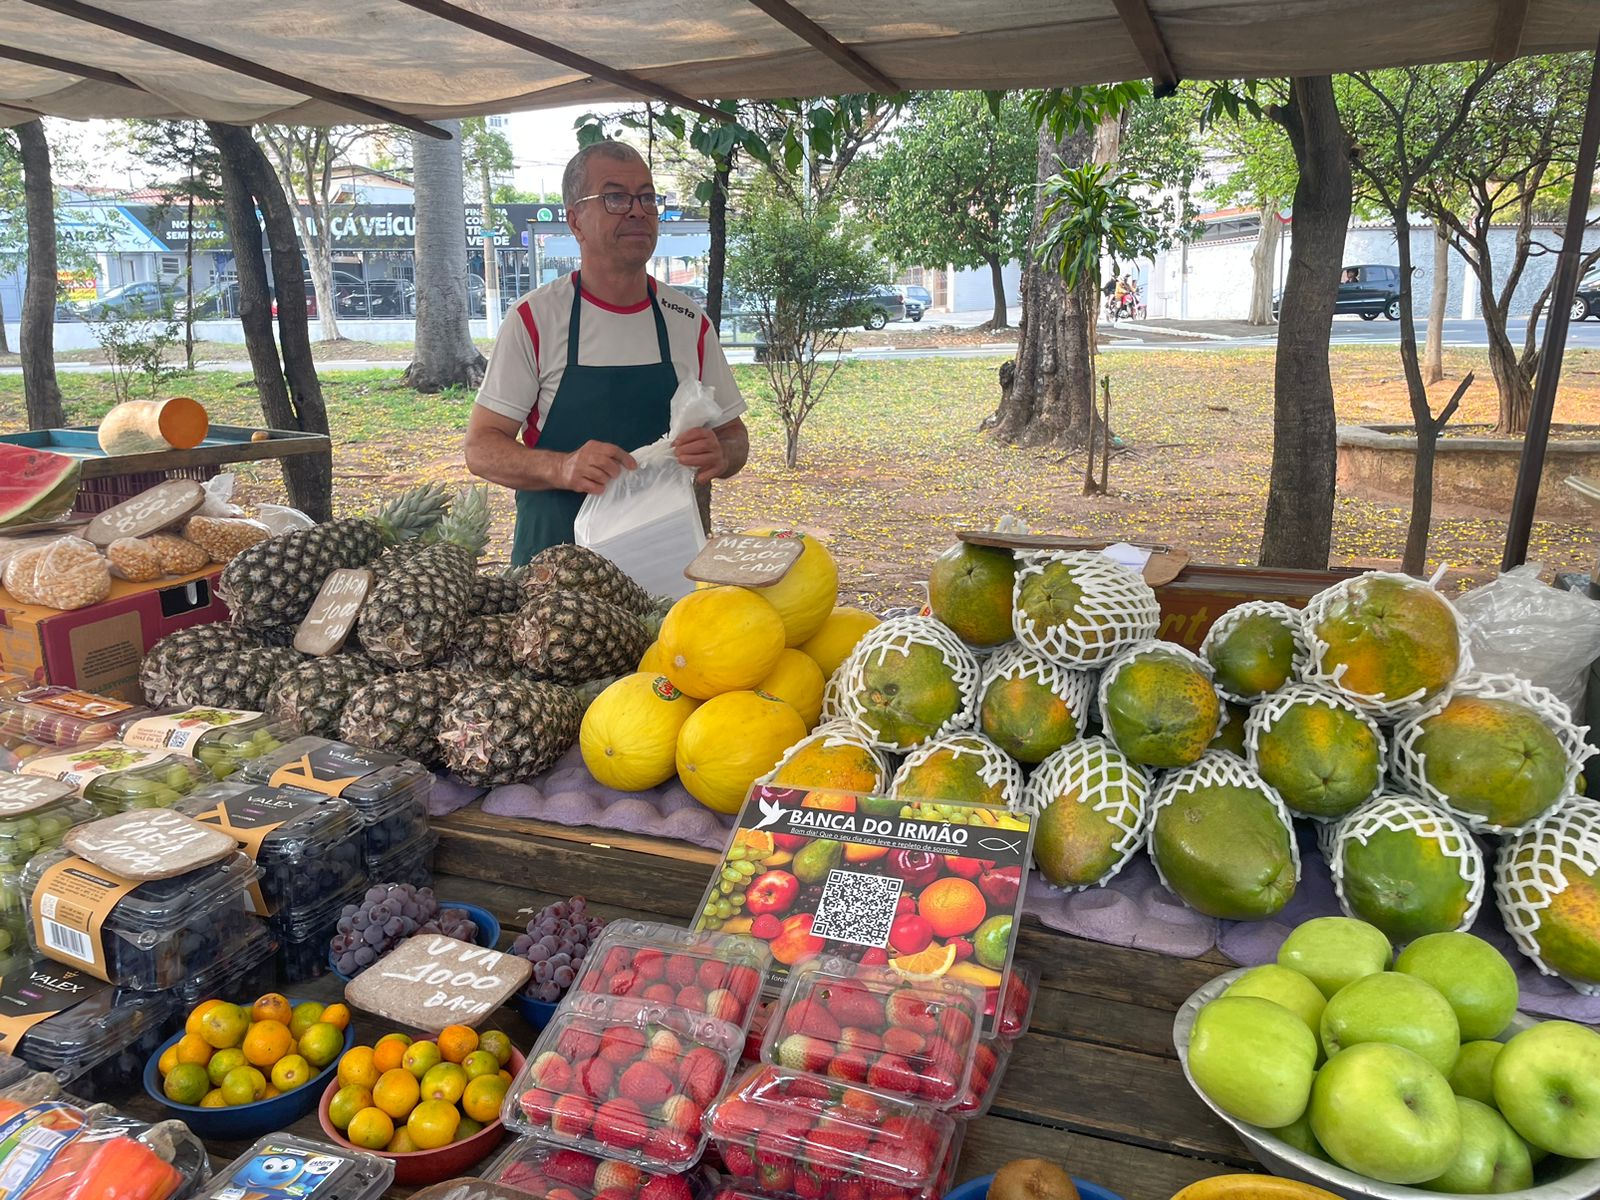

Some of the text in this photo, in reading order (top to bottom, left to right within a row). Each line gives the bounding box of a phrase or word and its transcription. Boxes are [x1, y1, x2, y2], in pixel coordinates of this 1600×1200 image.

[467, 236, 510, 246] VEDE
[661, 298, 695, 319] kipsta
[247, 795, 299, 809] VALEX
[150, 812, 209, 845] UVA
[789, 809, 968, 845] BANCA DO IRMÃO
[897, 842, 921, 850] repleto
[427, 937, 503, 971] UVA
[30, 971, 85, 993] VALEX
